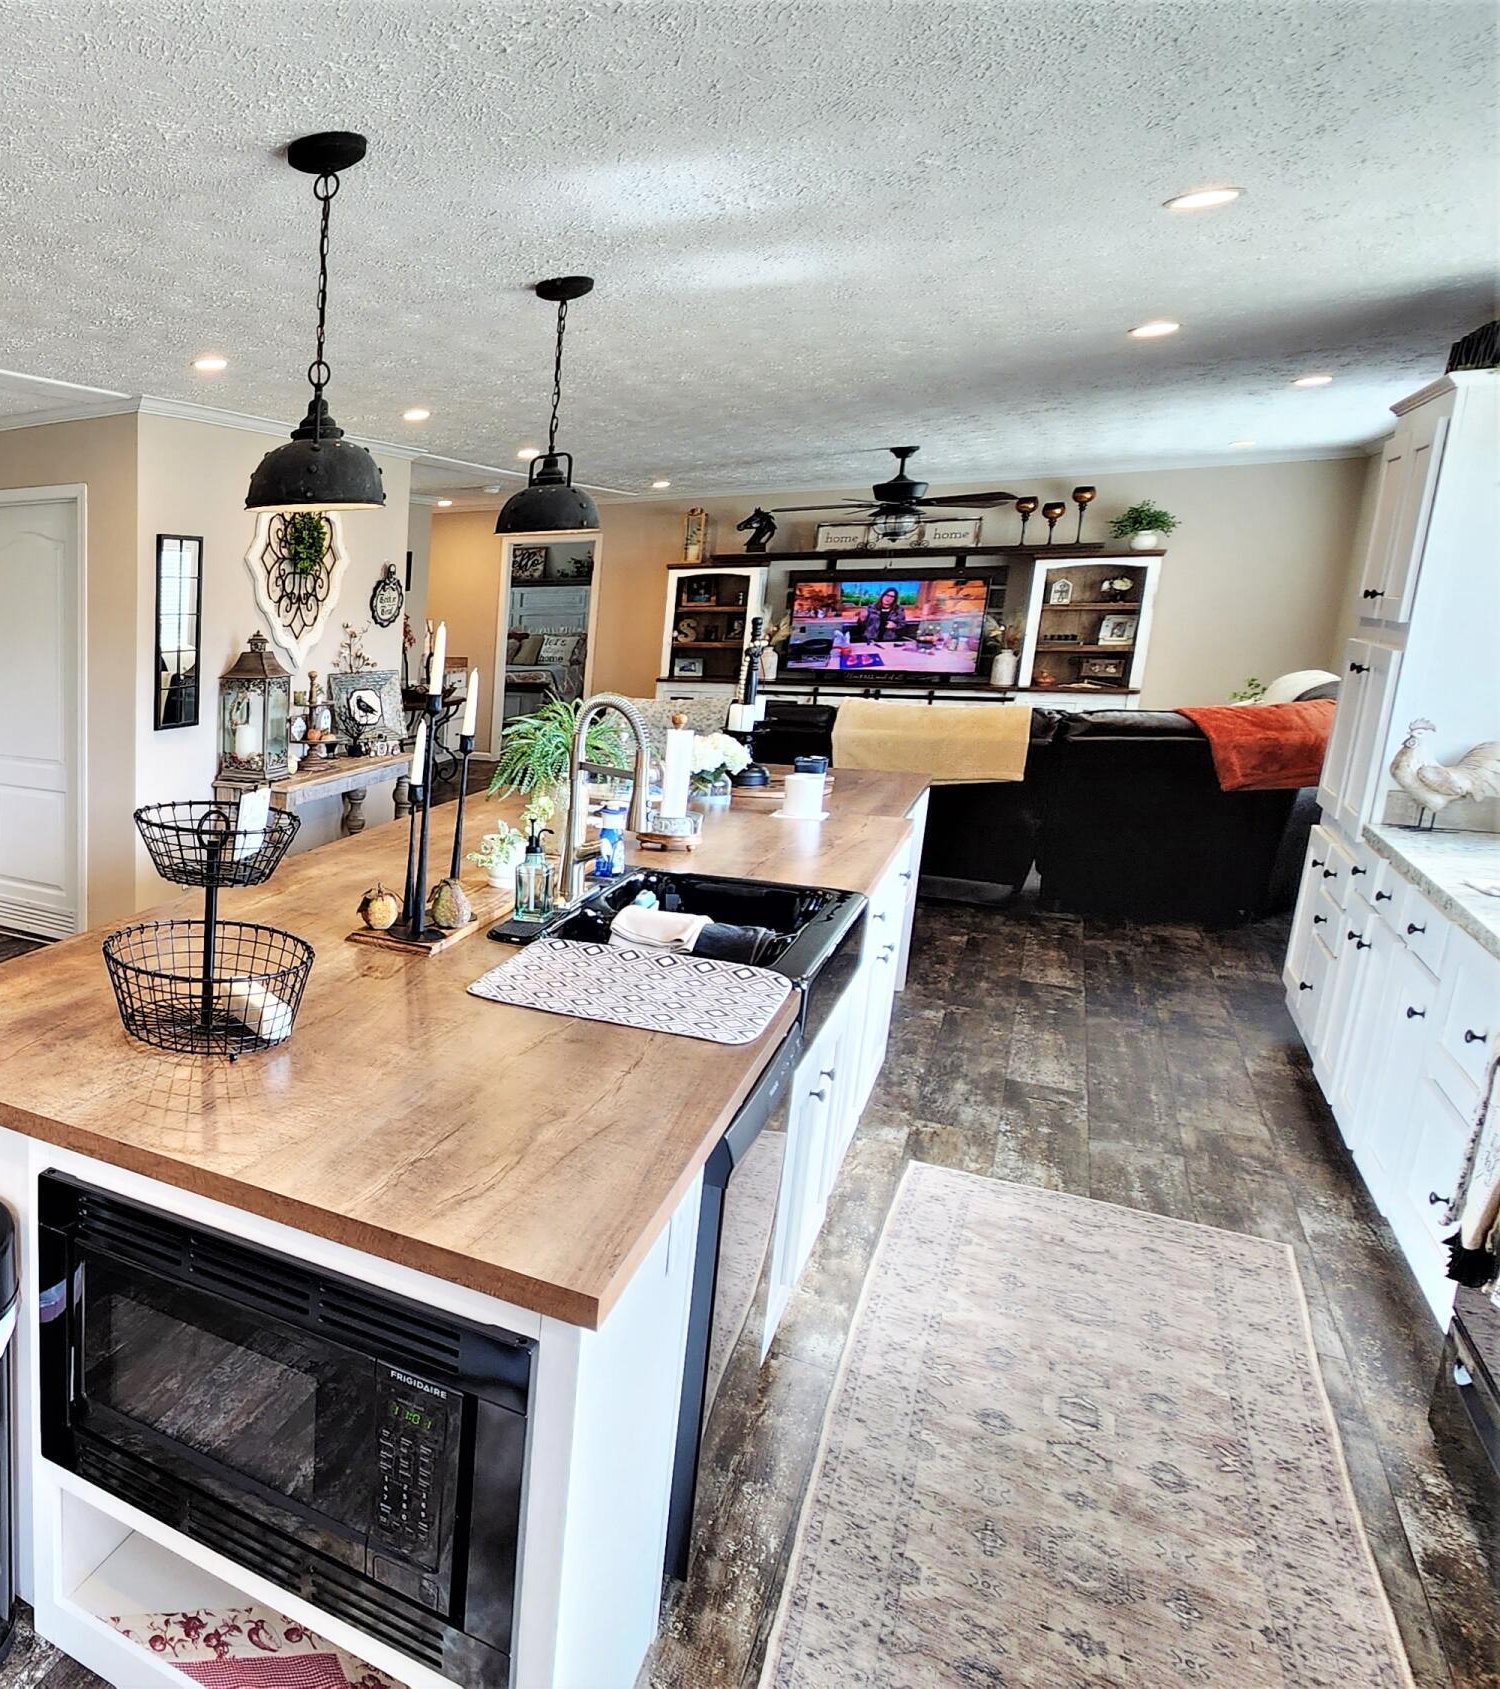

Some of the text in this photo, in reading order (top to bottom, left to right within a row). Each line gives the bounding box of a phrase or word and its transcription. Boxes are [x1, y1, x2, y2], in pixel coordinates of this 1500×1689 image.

[825, 533, 859, 544] home
[933, 528, 970, 541] home
[390, 1369, 448, 1400] FRIGIDAIRE
